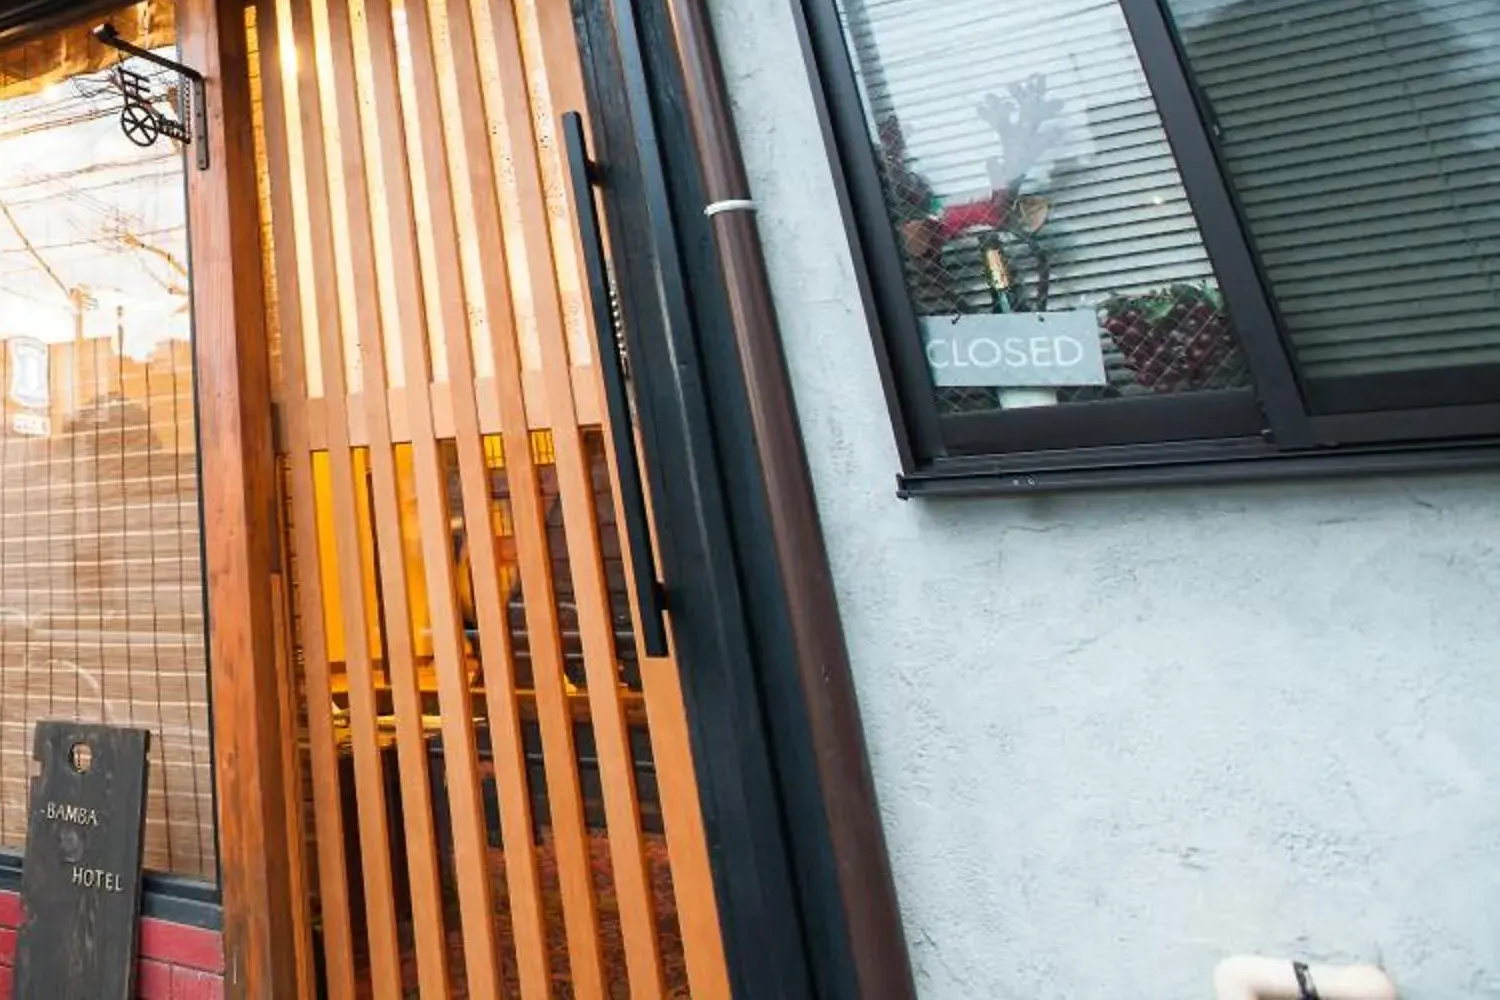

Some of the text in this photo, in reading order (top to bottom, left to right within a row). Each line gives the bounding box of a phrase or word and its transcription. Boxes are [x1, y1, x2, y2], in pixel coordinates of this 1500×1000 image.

[925, 335, 1085, 369] CLOSED
[46, 802, 100, 826] BAMBA
[71, 866, 123, 892] HOTEL
